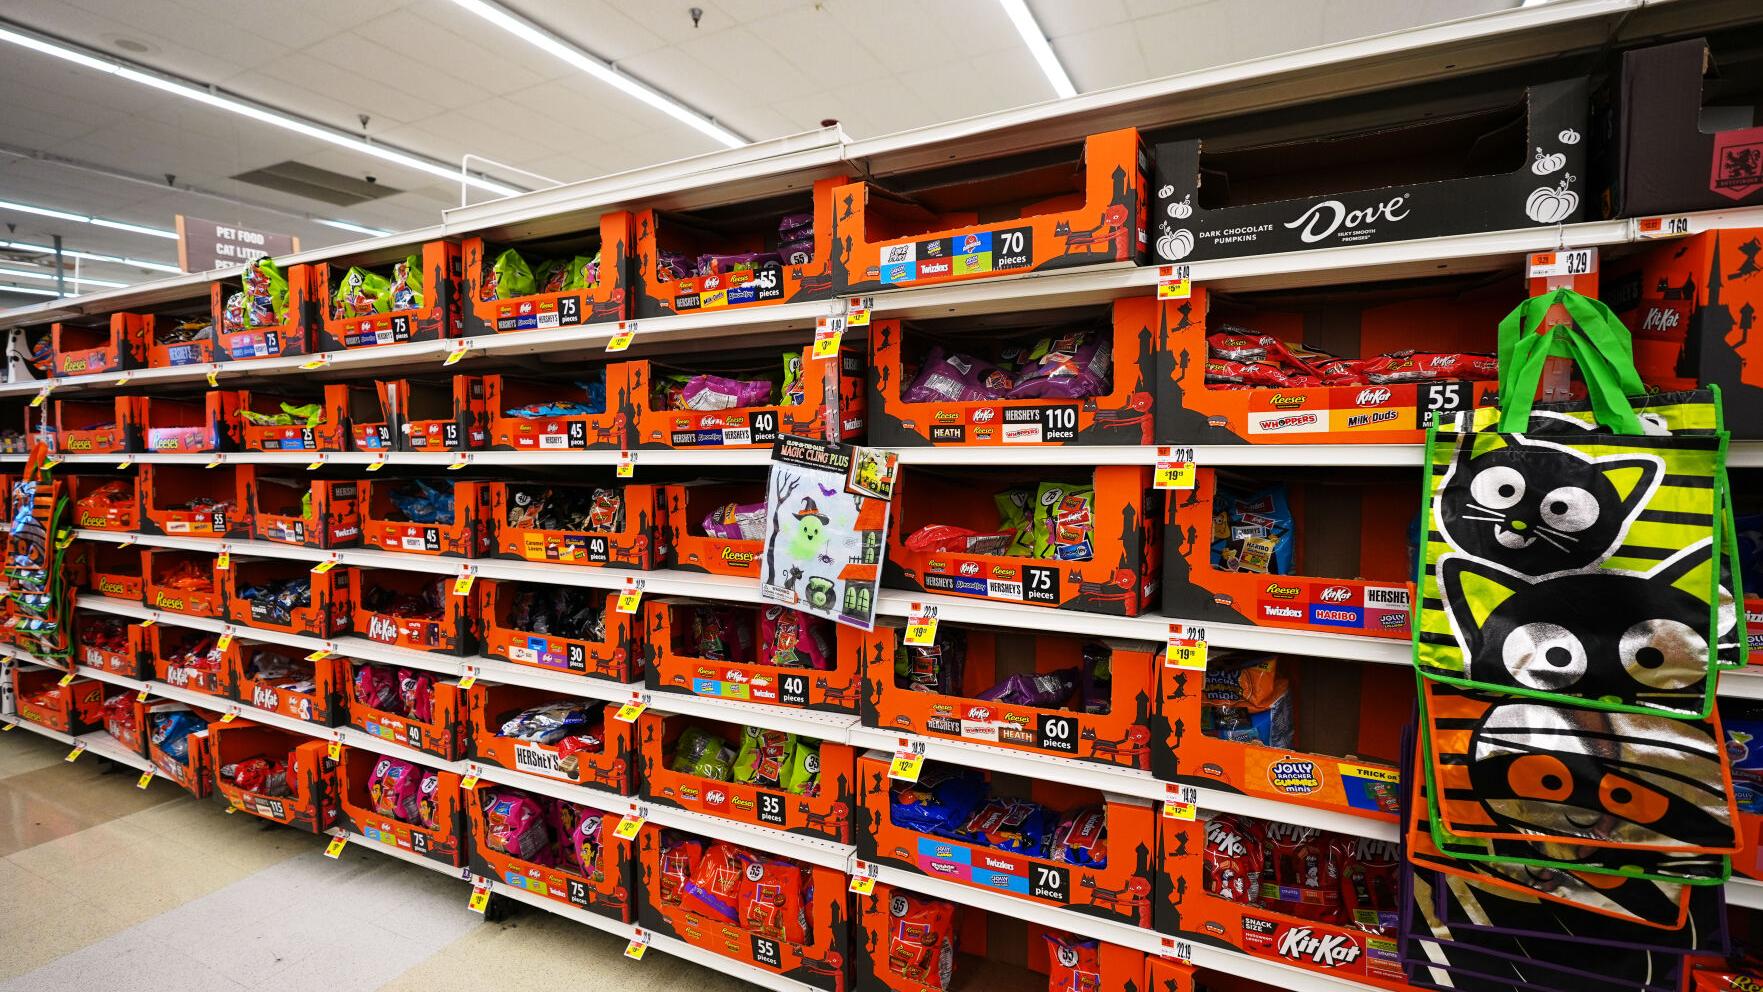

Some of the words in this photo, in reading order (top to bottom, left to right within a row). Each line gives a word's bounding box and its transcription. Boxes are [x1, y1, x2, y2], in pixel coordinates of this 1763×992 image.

[1283, 196, 1410, 243] Dove
[216, 226, 236, 238] PET
[238, 230, 264, 245] FOOD
[1199, 231, 1221, 240] DARK
[1223, 224, 1273, 236] CHOCOLATE
[1000, 232, 1024, 254] 70
[1214, 234, 1257, 244] PUMPKINS
[216, 243, 234, 255] CAT
[793, 255, 805, 264] 55
[999, 255, 1026, 267] pieces
[921, 263, 948, 274] Twizzlers
[760, 270, 776, 288] 55
[759, 290, 779, 298] pieces
[562, 300, 576, 314] 75
[676, 296, 699, 308] HERSHEY'S
[395, 318, 405, 332] 75
[539, 314, 558, 325] HERSHEY'S
[562, 316, 577, 324] pieces
[1642, 308, 1679, 331] KitKat
[267, 333, 276, 346] 75
[1270, 394, 1306, 404] Reese's
[1356, 389, 1391, 404] KitKat
[1428, 385, 1459, 409] 55
[934, 411, 960, 420] Reese's
[973, 410, 995, 421] KitKat
[1005, 409, 1040, 421] HERSHEY'S
[1046, 408, 1075, 428] 110
[1347, 416, 1368, 427] Milk
[1372, 410, 1398, 422] Duds
[755, 414, 772, 430] 40
[1261, 414, 1317, 430] WHOPPERS
[302, 429, 312, 440] 25
[380, 428, 388, 439] 30
[447, 425, 456, 438] 15
[571, 424, 582, 438] 45
[725, 429, 750, 441] HERSHEY'S
[755, 433, 775, 441] pieces
[934, 428, 961, 438] HEATH
[1047, 430, 1074, 442] pieces
[673, 432, 696, 443] HERSHEY'S
[781, 445, 804, 459] MAGIC
[806, 450, 829, 464] CLING
[829, 452, 849, 468] PLUS
[214, 514, 223, 524] 55
[296, 521, 302, 533] 40
[426, 530, 436, 542] 45
[590, 540, 604, 553] 40
[722, 546, 753, 562] Reese's
[928, 559, 946, 568] Reese's
[960, 562, 979, 575] KitKat
[992, 565, 1016, 576] Reese's
[925, 577, 954, 589] HERSHEY'S
[1030, 569, 1050, 589] 75
[990, 582, 1021, 594] HERSHEY'S
[1266, 583, 1301, 595] Reese's
[1028, 591, 1054, 600] pieces
[1320, 588, 1352, 602] KitKat
[1264, 605, 1302, 617] Twizzlers
[1316, 611, 1356, 621] HARIBO
[1380, 614, 1404, 622] JOLLY
[369, 616, 397, 639] KitKat
[570, 647, 582, 661] 30
[697, 666, 716, 677] Reese's
[784, 678, 802, 693] 40
[254, 686, 278, 708] KitKat
[752, 688, 776, 698] Twizzlers
[783, 694, 804, 702] pieces
[1208, 691, 1239, 701] minis
[1005, 713, 1030, 723] Reese's
[928, 719, 960, 732] HERSHEY'S
[1045, 720, 1069, 738] 60
[409, 727, 419, 740] 40
[1003, 730, 1032, 742] HEATH
[1043, 738, 1071, 750] pieces
[516, 747, 558, 770] HERSHEY'S
[805, 755, 818, 769] 35
[1274, 762, 1313, 773] JOLLY
[1357, 769, 1386, 779] TRICK
[1273, 779, 1318, 787] GUMMIES
[270, 801, 283, 813] 115
[732, 795, 754, 808] Reese's
[763, 796, 779, 813] 35
[761, 812, 782, 822] pieces
[413, 833, 424, 845] 75
[986, 858, 1014, 871] Twizzlers
[1038, 868, 1060, 888] 70
[571, 882, 584, 896] 75
[1036, 887, 1062, 899] pieces
[571, 896, 587, 904] pieces
[894, 898, 905, 912] 55
[1245, 918, 1272, 929] SNACK
[1245, 924, 1263, 932] SIZE
[757, 939, 774, 955] 55
[1279, 927, 1361, 966] KitKat
[757, 954, 777, 964] pieces
[1062, 947, 1074, 960] 55
